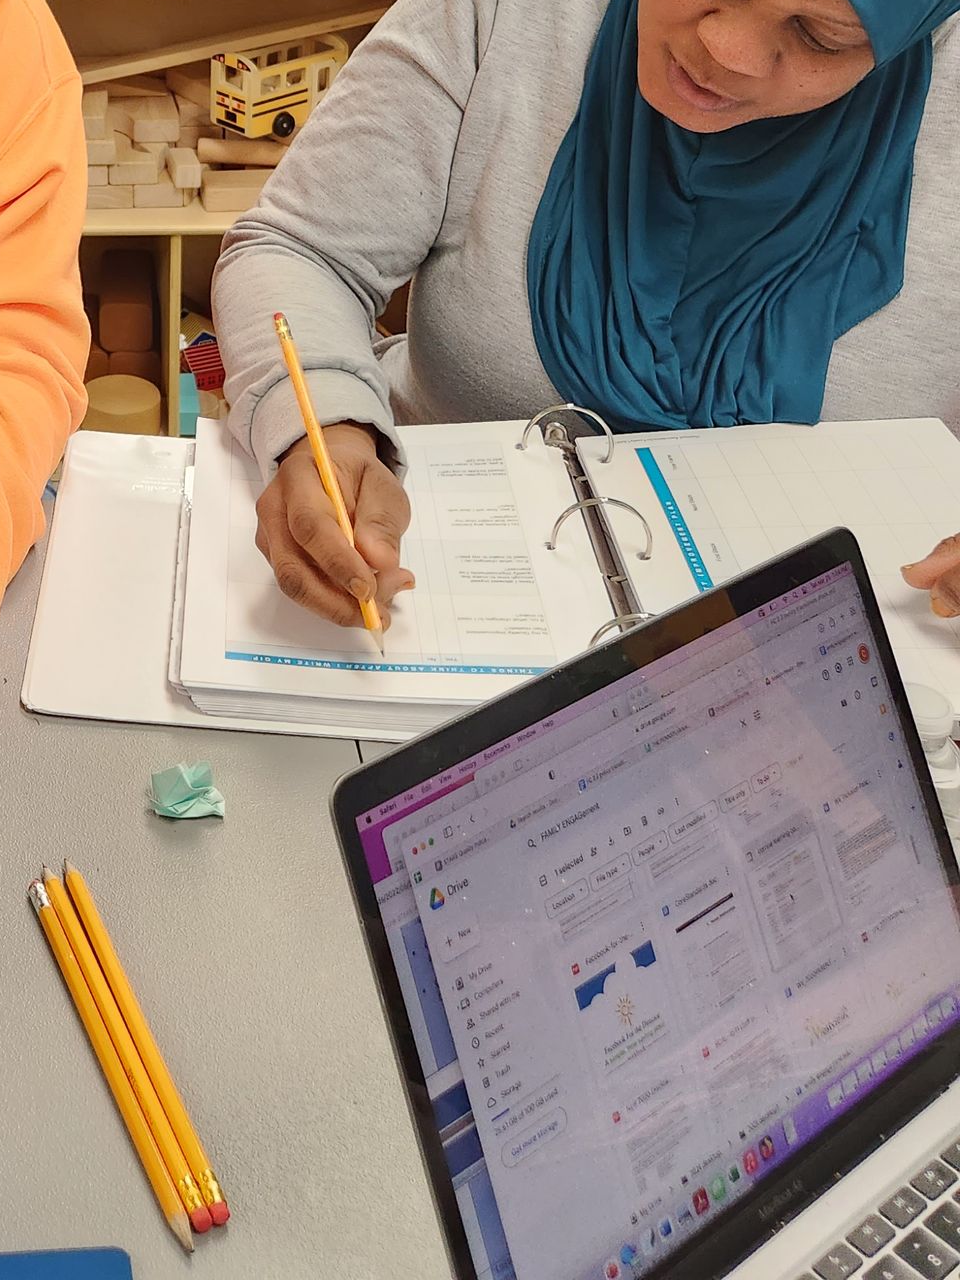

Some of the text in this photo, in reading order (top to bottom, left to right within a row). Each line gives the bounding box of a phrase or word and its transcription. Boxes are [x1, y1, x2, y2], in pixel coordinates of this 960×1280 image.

[675, 521, 705, 577] IMPROVEMENT
[297, 659, 331, 668] WRITE
[378, 718, 554, 816] Safari File Edit View History Bookmarks Window Help
[539, 800, 601, 841] FAMILY ENGAGement
[674, 811, 707, 836] Last modified
[637, 842, 656, 859] People
[557, 854, 584, 874] selected
[595, 865, 618, 884] File type
[446, 875, 469, 896] Drive
[551, 890, 576, 910] Location
[457, 926, 471, 940] New
[468, 960, 493, 982] My Drive
[473, 976, 504, 1002] Computers
[478, 1001, 500, 1021] Shared
[498, 994, 511, 1008] with
[483, 1022, 504, 1040] Recent
[489, 1040, 511, 1059] Starred
[494, 1063, 511, 1079] Trash
[499, 1079, 523, 1099] Storage
[524, 1102, 536, 1116] 100
[543, 1087, 558, 1103] used
[510, 1119, 559, 1158] Get more storage
[927, 1254, 942, 1266] 8
